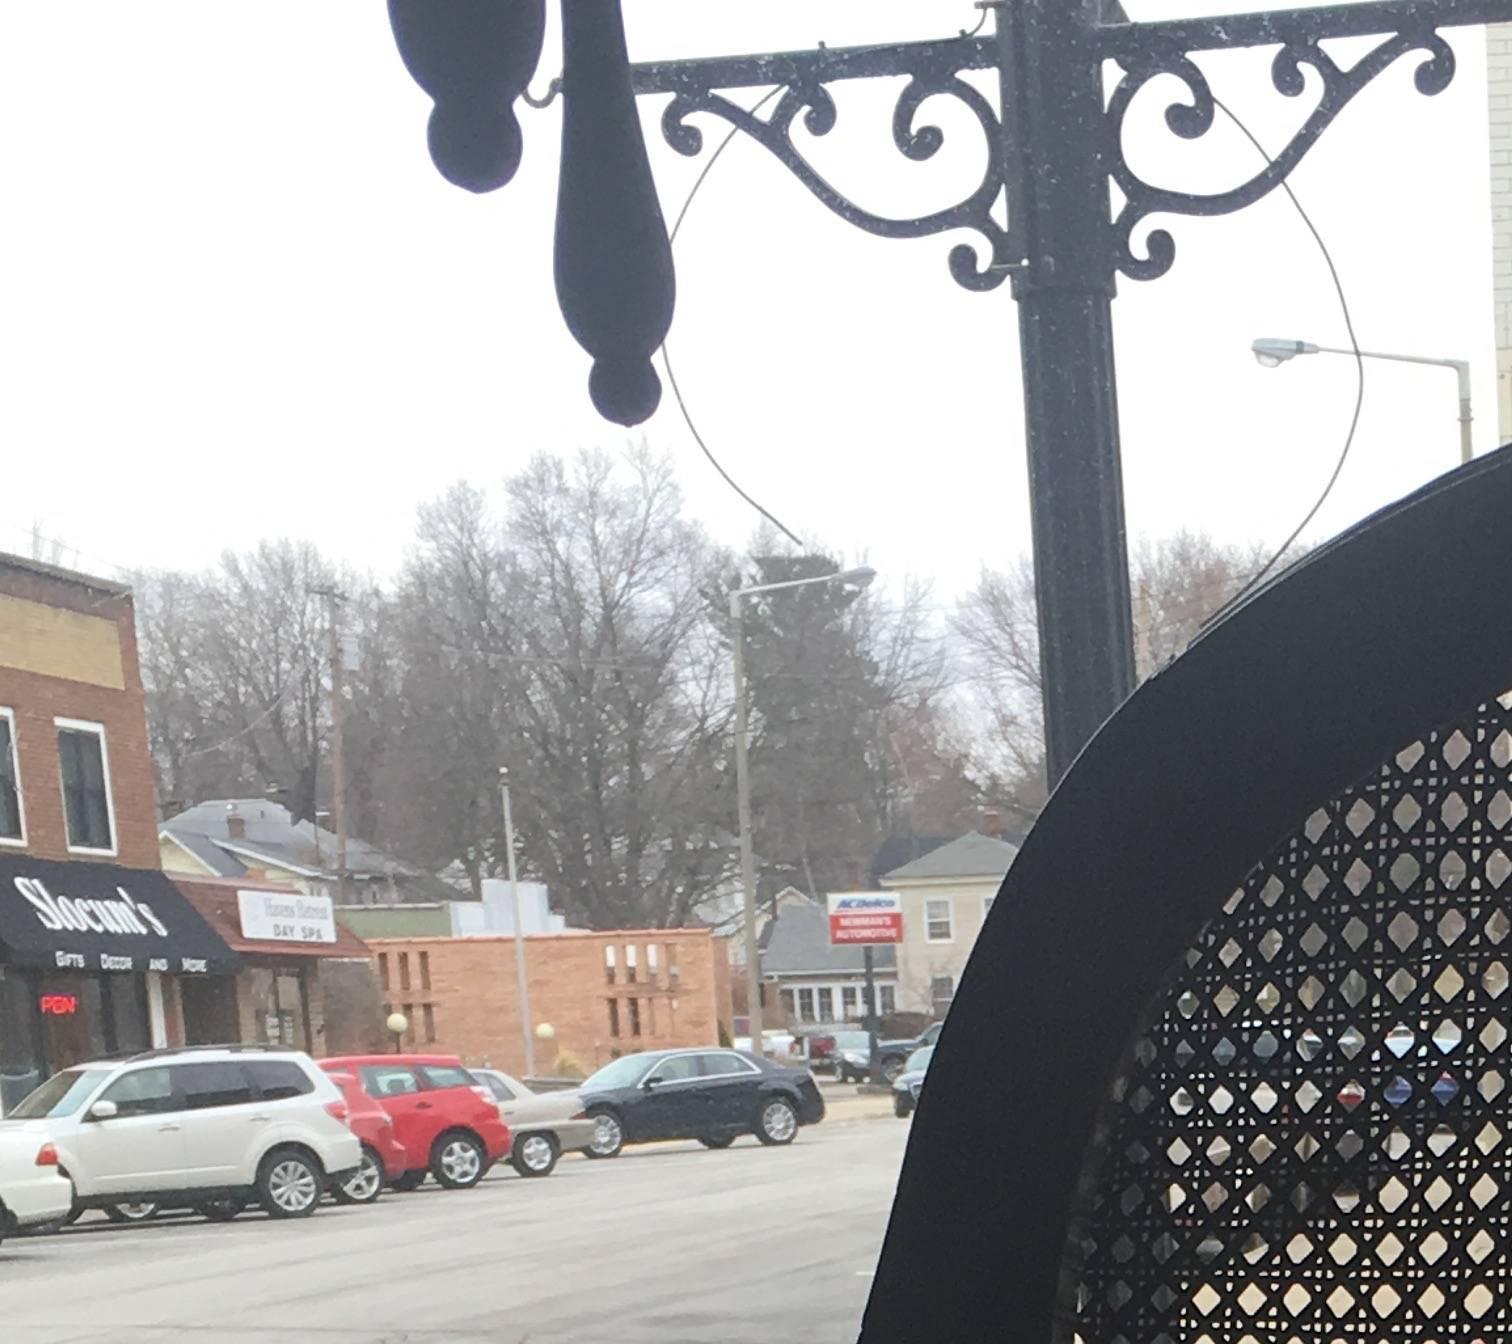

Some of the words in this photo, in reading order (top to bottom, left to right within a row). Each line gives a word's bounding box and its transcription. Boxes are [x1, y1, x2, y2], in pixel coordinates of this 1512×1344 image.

[14, 876, 168, 937] Slocum's
[273, 922, 296, 938] DAY
[301, 925, 324, 941] SPA
